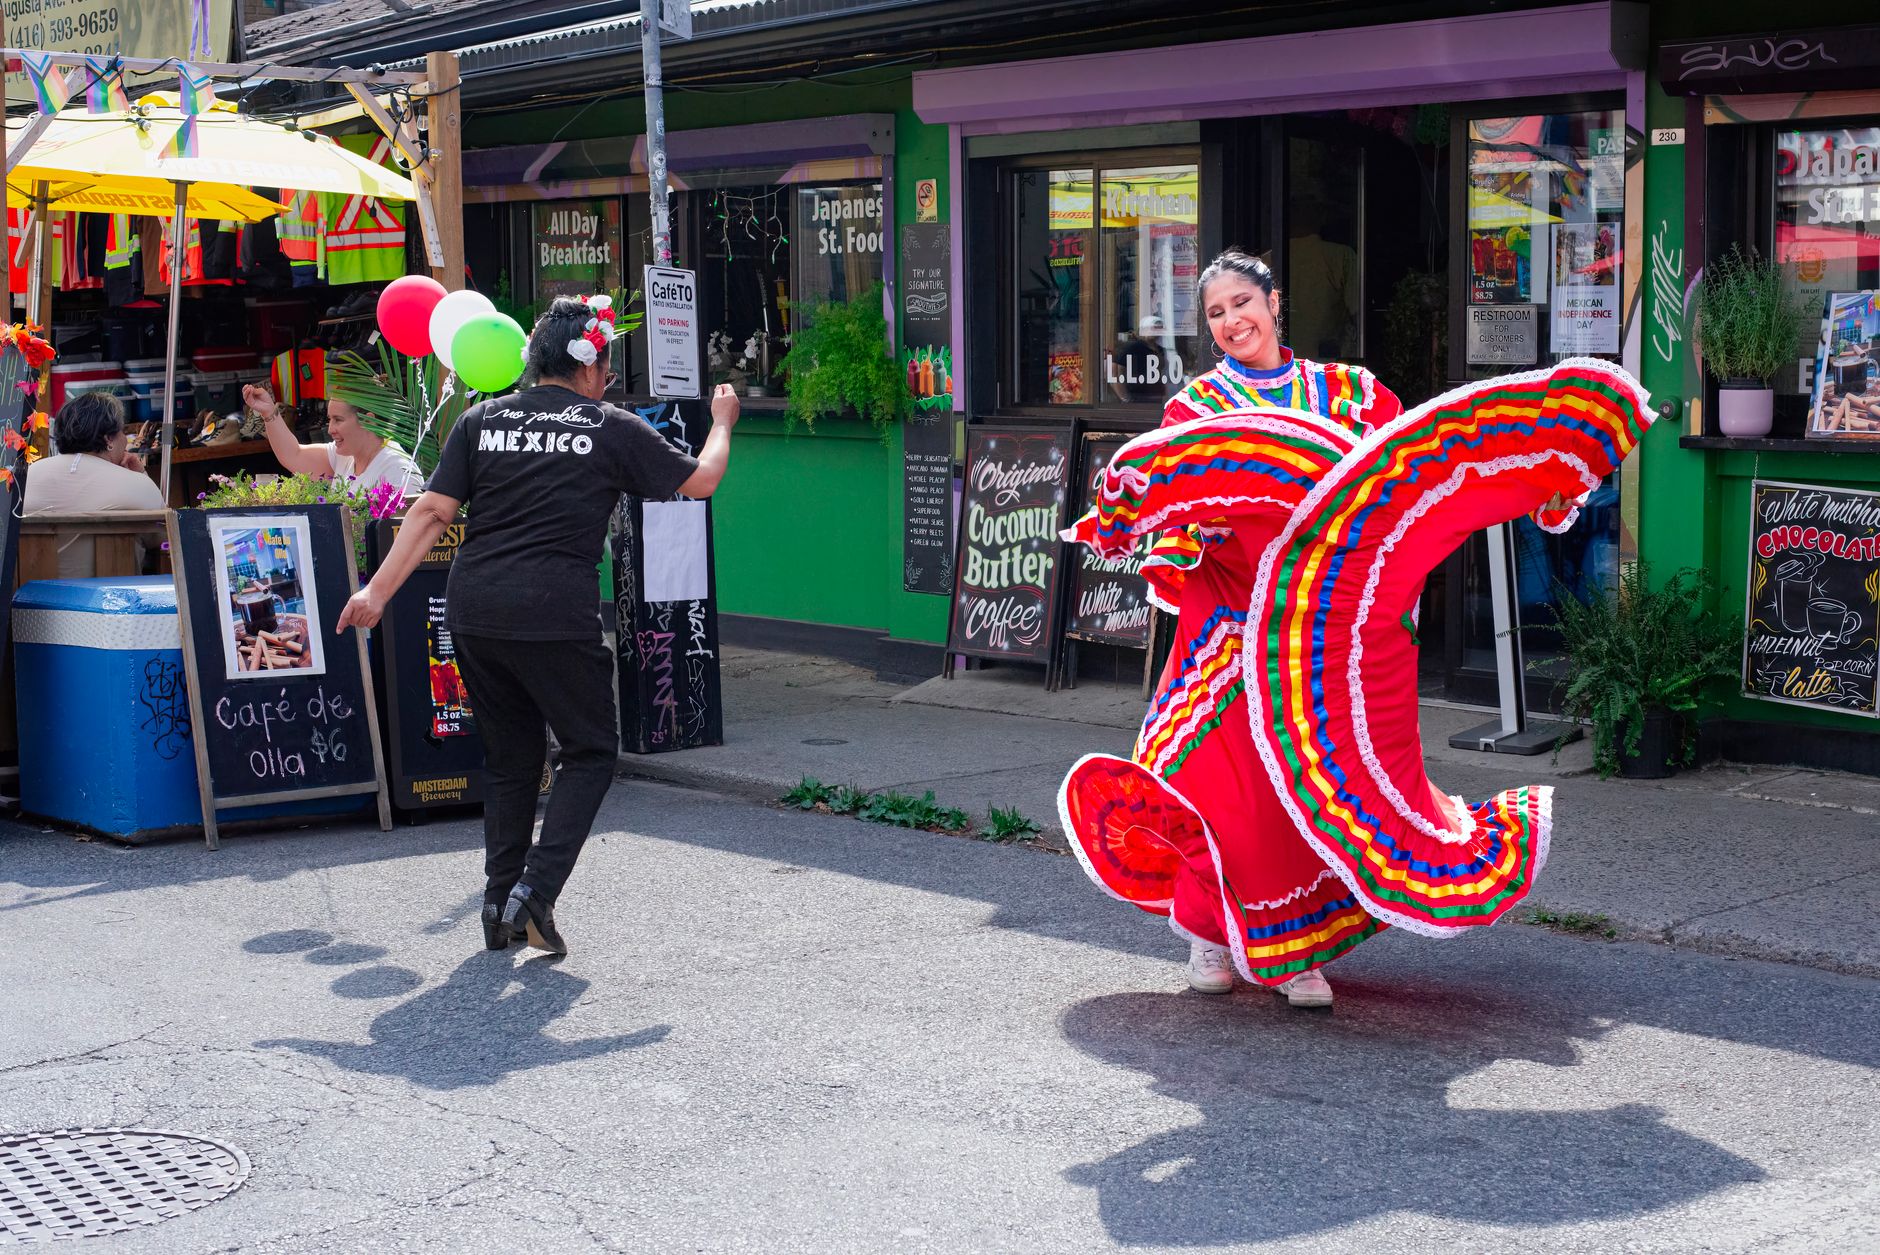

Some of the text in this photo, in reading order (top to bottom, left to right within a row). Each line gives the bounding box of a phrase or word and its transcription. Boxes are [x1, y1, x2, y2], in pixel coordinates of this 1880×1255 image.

[0, 0, 41, 21] ugusta
[10, 23, 45, 50] (416)
[50, 8, 118, 43] 593-9659
[1658, 131, 1677, 142] 230
[1106, 187, 1192, 218] Kitchen
[1808, 187, 1853, 225] St.
[551, 210, 598, 240] All Day
[819, 228, 843, 255] St.
[541, 240, 610, 267] Breakfast
[912, 268, 942, 278] TRY OUR
[652, 281, 693, 302] CaféTO
[908, 280, 945, 290] SIGNATURE
[653, 300, 693, 310] PATIO INSTALLATION
[1475, 291, 1494, 300] $8.75
[1567, 299, 1603, 308] MEXICAN
[658, 317, 690, 328] NO PARKING
[1473, 310, 1531, 321] RESTROOM
[1558, 309, 1613, 319] INDEPENDENCE
[1494, 325, 1509, 333] FOR
[1576, 320, 1593, 329] DAY
[1479, 334, 1525, 343] CUSTOMERS
[1492, 344, 1510, 353] ONLY
[478, 426, 593, 455] MÉXICO
[976, 455, 1065, 507] Original
[1760, 490, 1819, 523] White
[968, 503, 1059, 547] Coconut
[964, 546, 1054, 590] Butter
[1079, 582, 1122, 617] White
[966, 597, 1042, 648] Coffee
[1814, 658, 1876, 675] POPCORN
[1783, 666, 1832, 698] latte
[216, 688, 296, 742] Café
[307, 685, 354, 724] de
[436, 711, 449, 720] 1.5
[437, 723, 460, 733] $8.75
[250, 726, 347, 778] Olla $6
[412, 777, 468, 794] AMSTERDAM
[420, 790, 461, 803] Brewery
